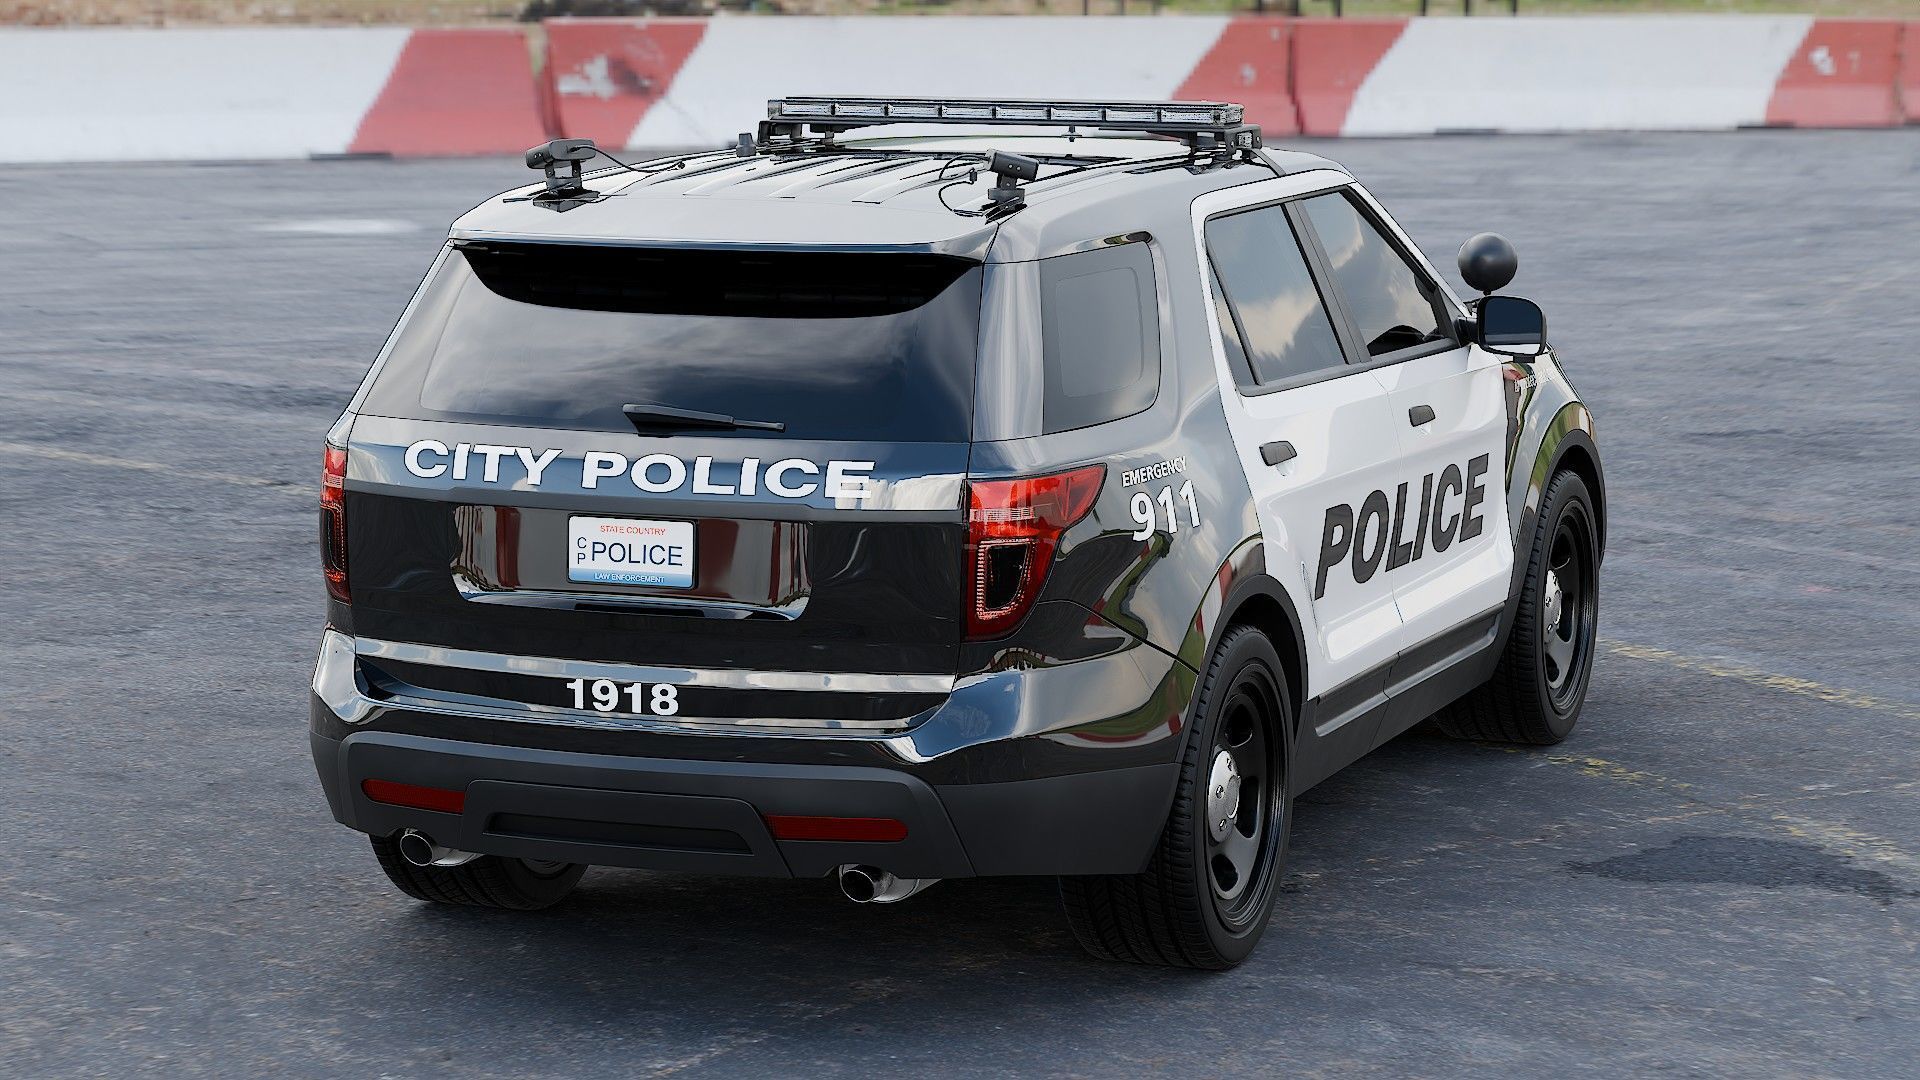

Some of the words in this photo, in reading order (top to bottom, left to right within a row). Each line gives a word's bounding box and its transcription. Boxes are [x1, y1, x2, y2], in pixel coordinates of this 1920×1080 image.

[404, 439, 563, 486] CITY
[580, 451, 875, 499] POLICE
[1121, 455, 1187, 488] EMERGENCY
[1130, 479, 1201, 541] 911
[1314, 452, 1490, 601] POLICE
[600, 525, 624, 534] STATE
[626, 527, 666, 535] COUNTRY
[591, 541, 683, 567] POLICE
[611, 574, 665, 583] ENFORCEMENT
[566, 678, 679, 716] 1918
